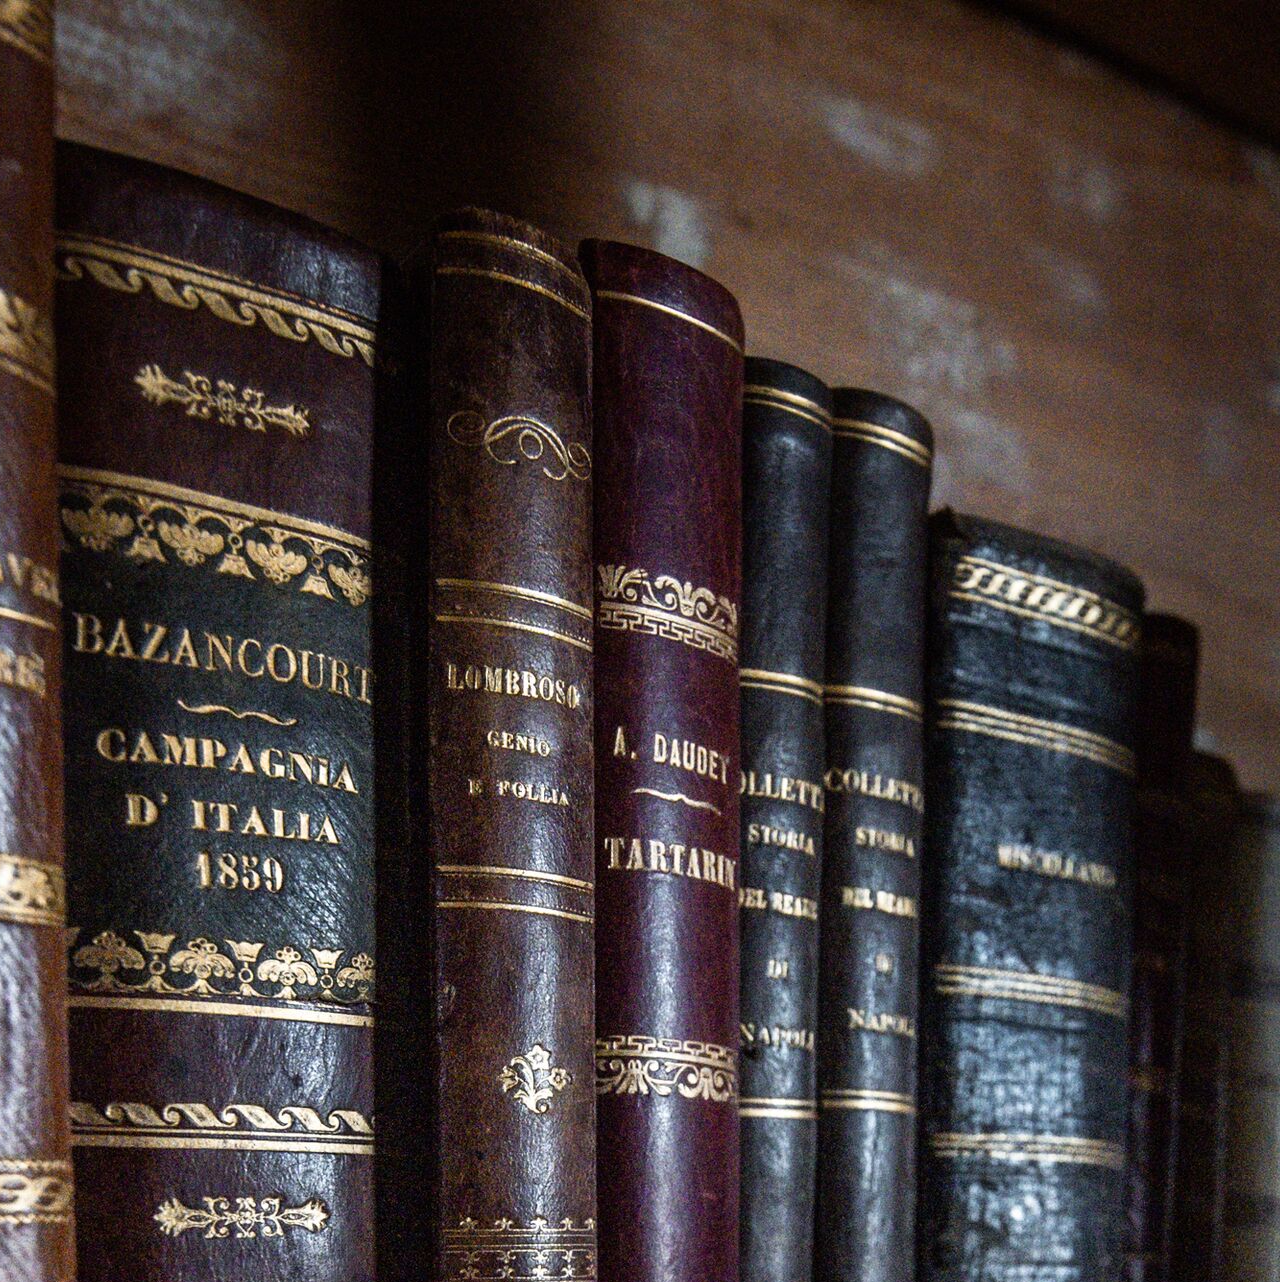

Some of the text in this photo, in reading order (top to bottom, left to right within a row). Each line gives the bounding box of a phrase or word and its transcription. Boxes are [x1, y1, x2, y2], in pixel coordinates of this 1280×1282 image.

[72, 611, 372, 704] BAZANCOURT
[446, 662, 581, 710] LOMBROSO
[96, 728, 359, 795] CAMPAGNIA
[486, 730, 552, 758] GENIO
[613, 725, 639, 760] A.
[496, 778, 570, 807] FOLLIA
[191, 799, 341, 845] ITALIA
[747, 823, 817, 856] STORIA
[194, 851, 285, 893] 1859
[604, 837, 738, 892] TARTARIN
